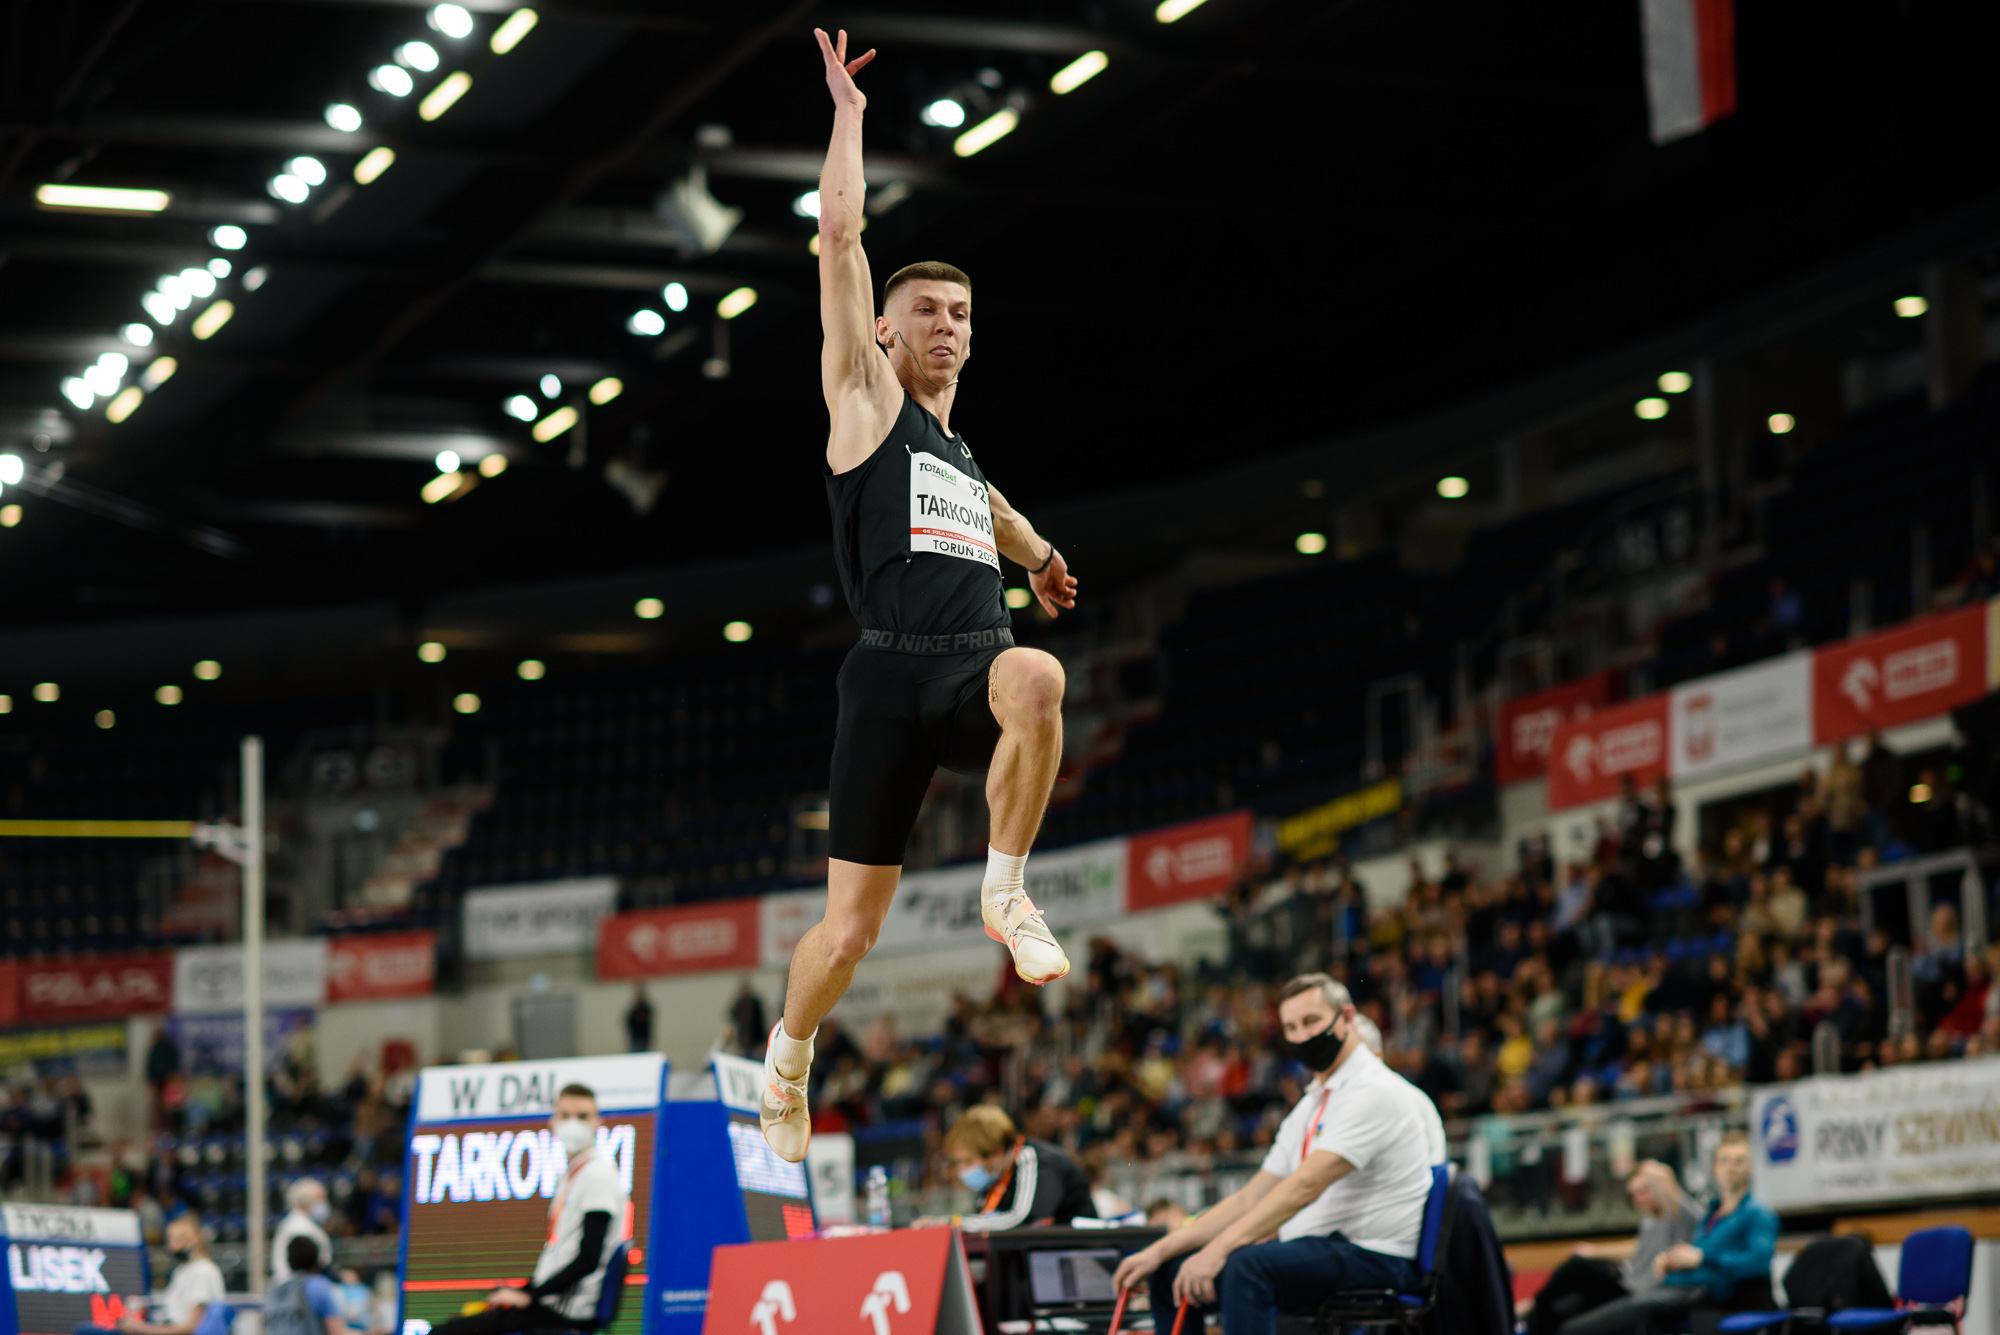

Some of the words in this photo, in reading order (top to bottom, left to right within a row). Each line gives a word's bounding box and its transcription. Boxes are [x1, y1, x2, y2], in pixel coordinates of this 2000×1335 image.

[916, 493, 993, 537] TARKOWS
[933, 539, 974, 557] TORUŃ
[896, 633, 950, 652] NIKE
[953, 629, 995, 649] PRO
[449, 1074, 484, 1112] W
[411, 1123, 636, 1204] TARKOWKI
[7, 1242, 111, 1294] LISEK
